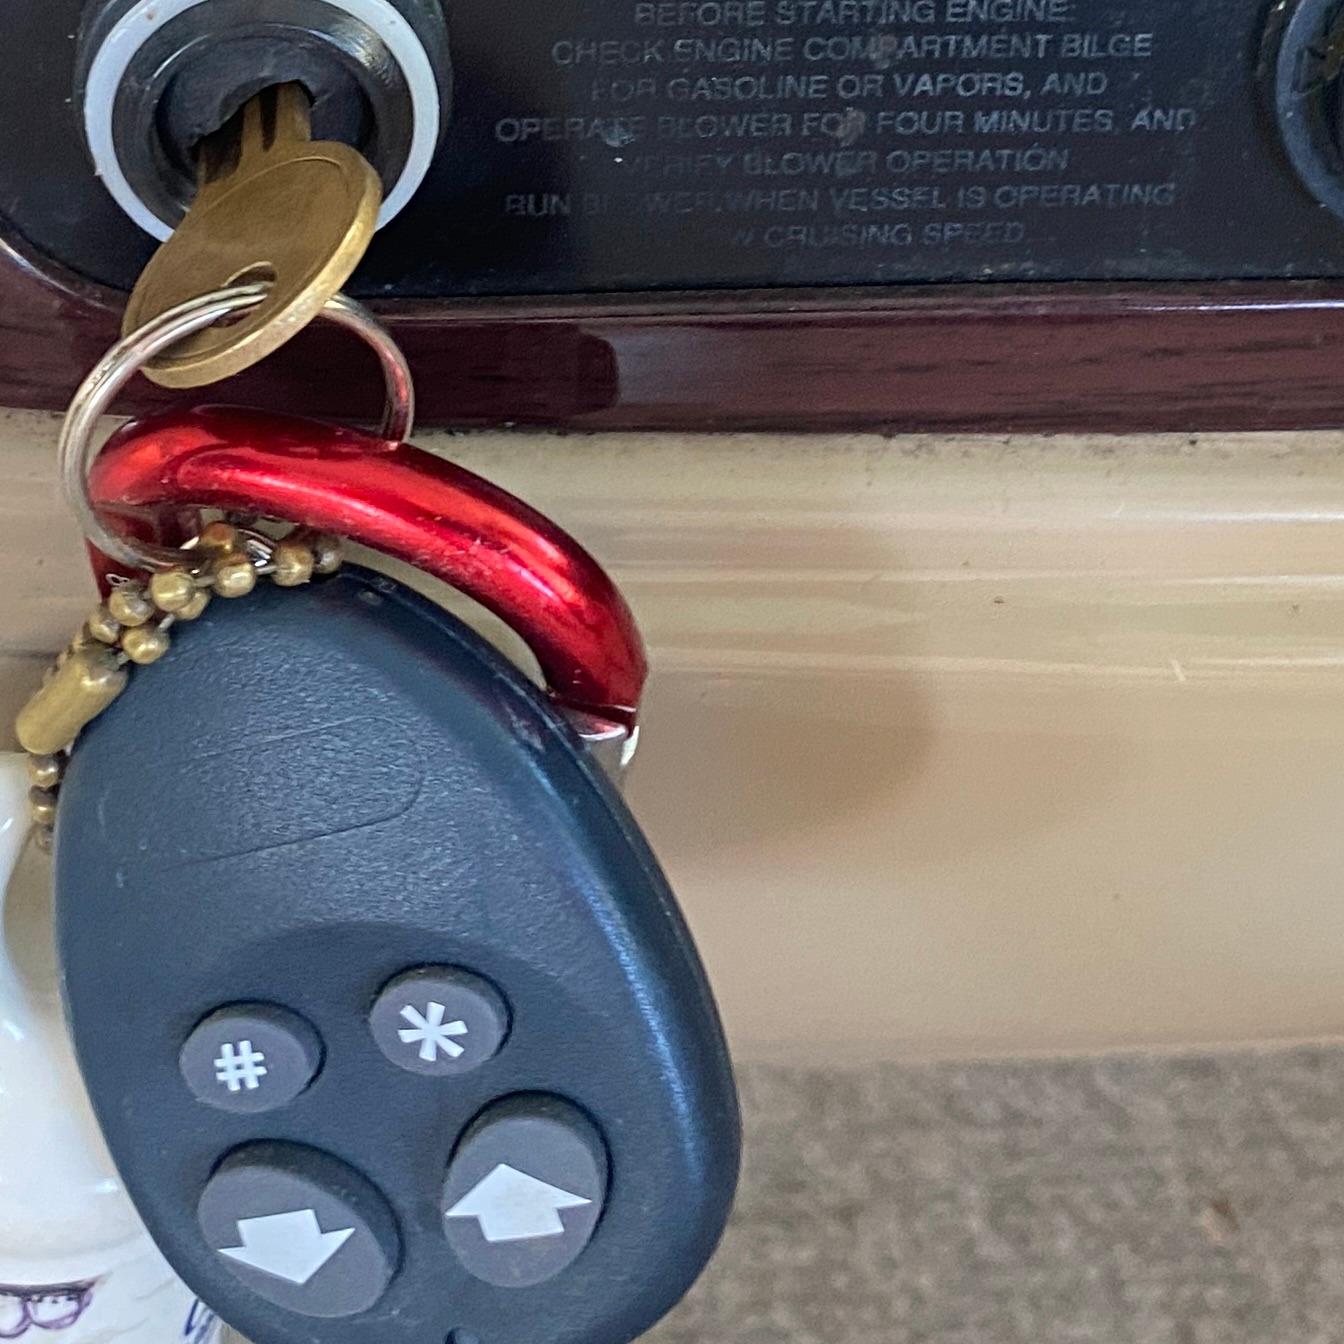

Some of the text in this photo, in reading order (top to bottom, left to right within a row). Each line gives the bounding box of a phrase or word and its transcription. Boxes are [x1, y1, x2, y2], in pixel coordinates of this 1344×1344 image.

[634, 0, 766, 26] BEFORE
[552, 32, 1154, 66] CHECK ENGINE COMPARTMENT BILGE
[591, 70, 1108, 102] FOR GASOLINE OR VAPORS, AND
[495, 116, 646, 144] OPERATE
[657, 112, 792, 140] BLOWER
[803, 109, 865, 139] FOR
[876, 109, 964, 136] FOUR
[1131, 106, 1197, 132] AND
[744, 151, 877, 176] BLOWER
[886, 147, 1069, 173] OPERATION
[507, 193, 571, 216] RUN
[726, 188, 819, 212] WHEN
[829, 185, 946, 212] VESSEL
[957, 185, 987, 208] IS
[993, 182, 1176, 208] OPERATING
[922, 221, 1026, 245] SPEED
